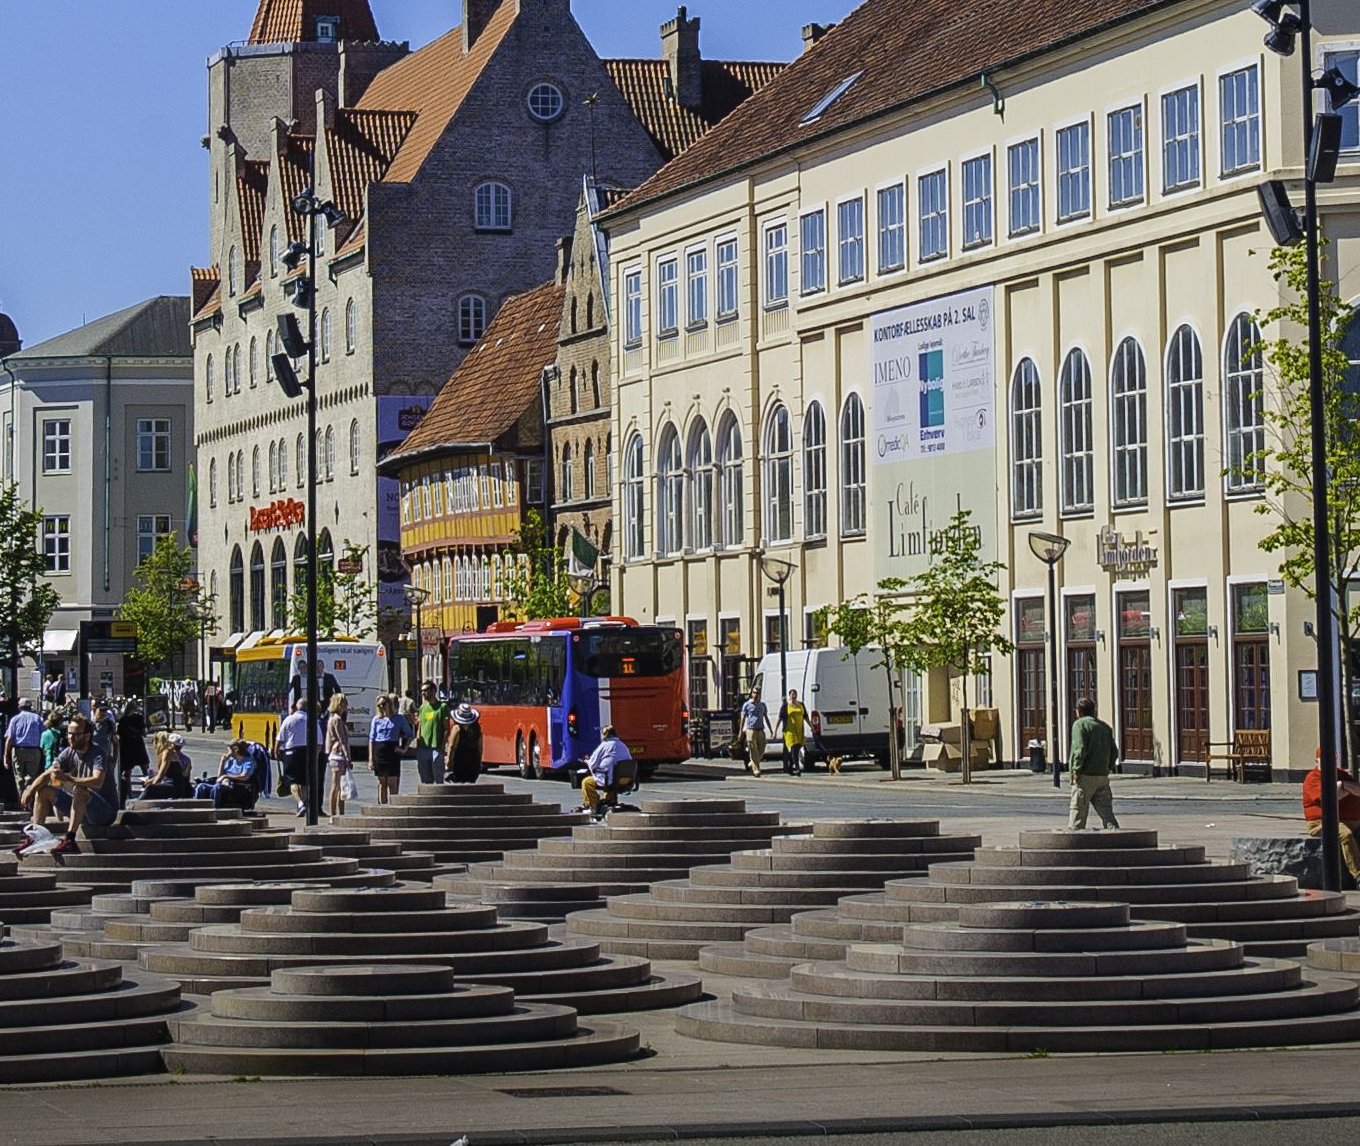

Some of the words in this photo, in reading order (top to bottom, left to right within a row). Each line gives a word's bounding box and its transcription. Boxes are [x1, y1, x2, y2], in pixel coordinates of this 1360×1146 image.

[874, 313, 942, 343] KONTORFÆLLESSKAB
[943, 306, 953, 327] PÅ
[954, 309, 961, 325] 2.
[962, 305, 976, 324] SAL
[874, 355, 911, 385] IMENO
[896, 480, 920, 516] Café
